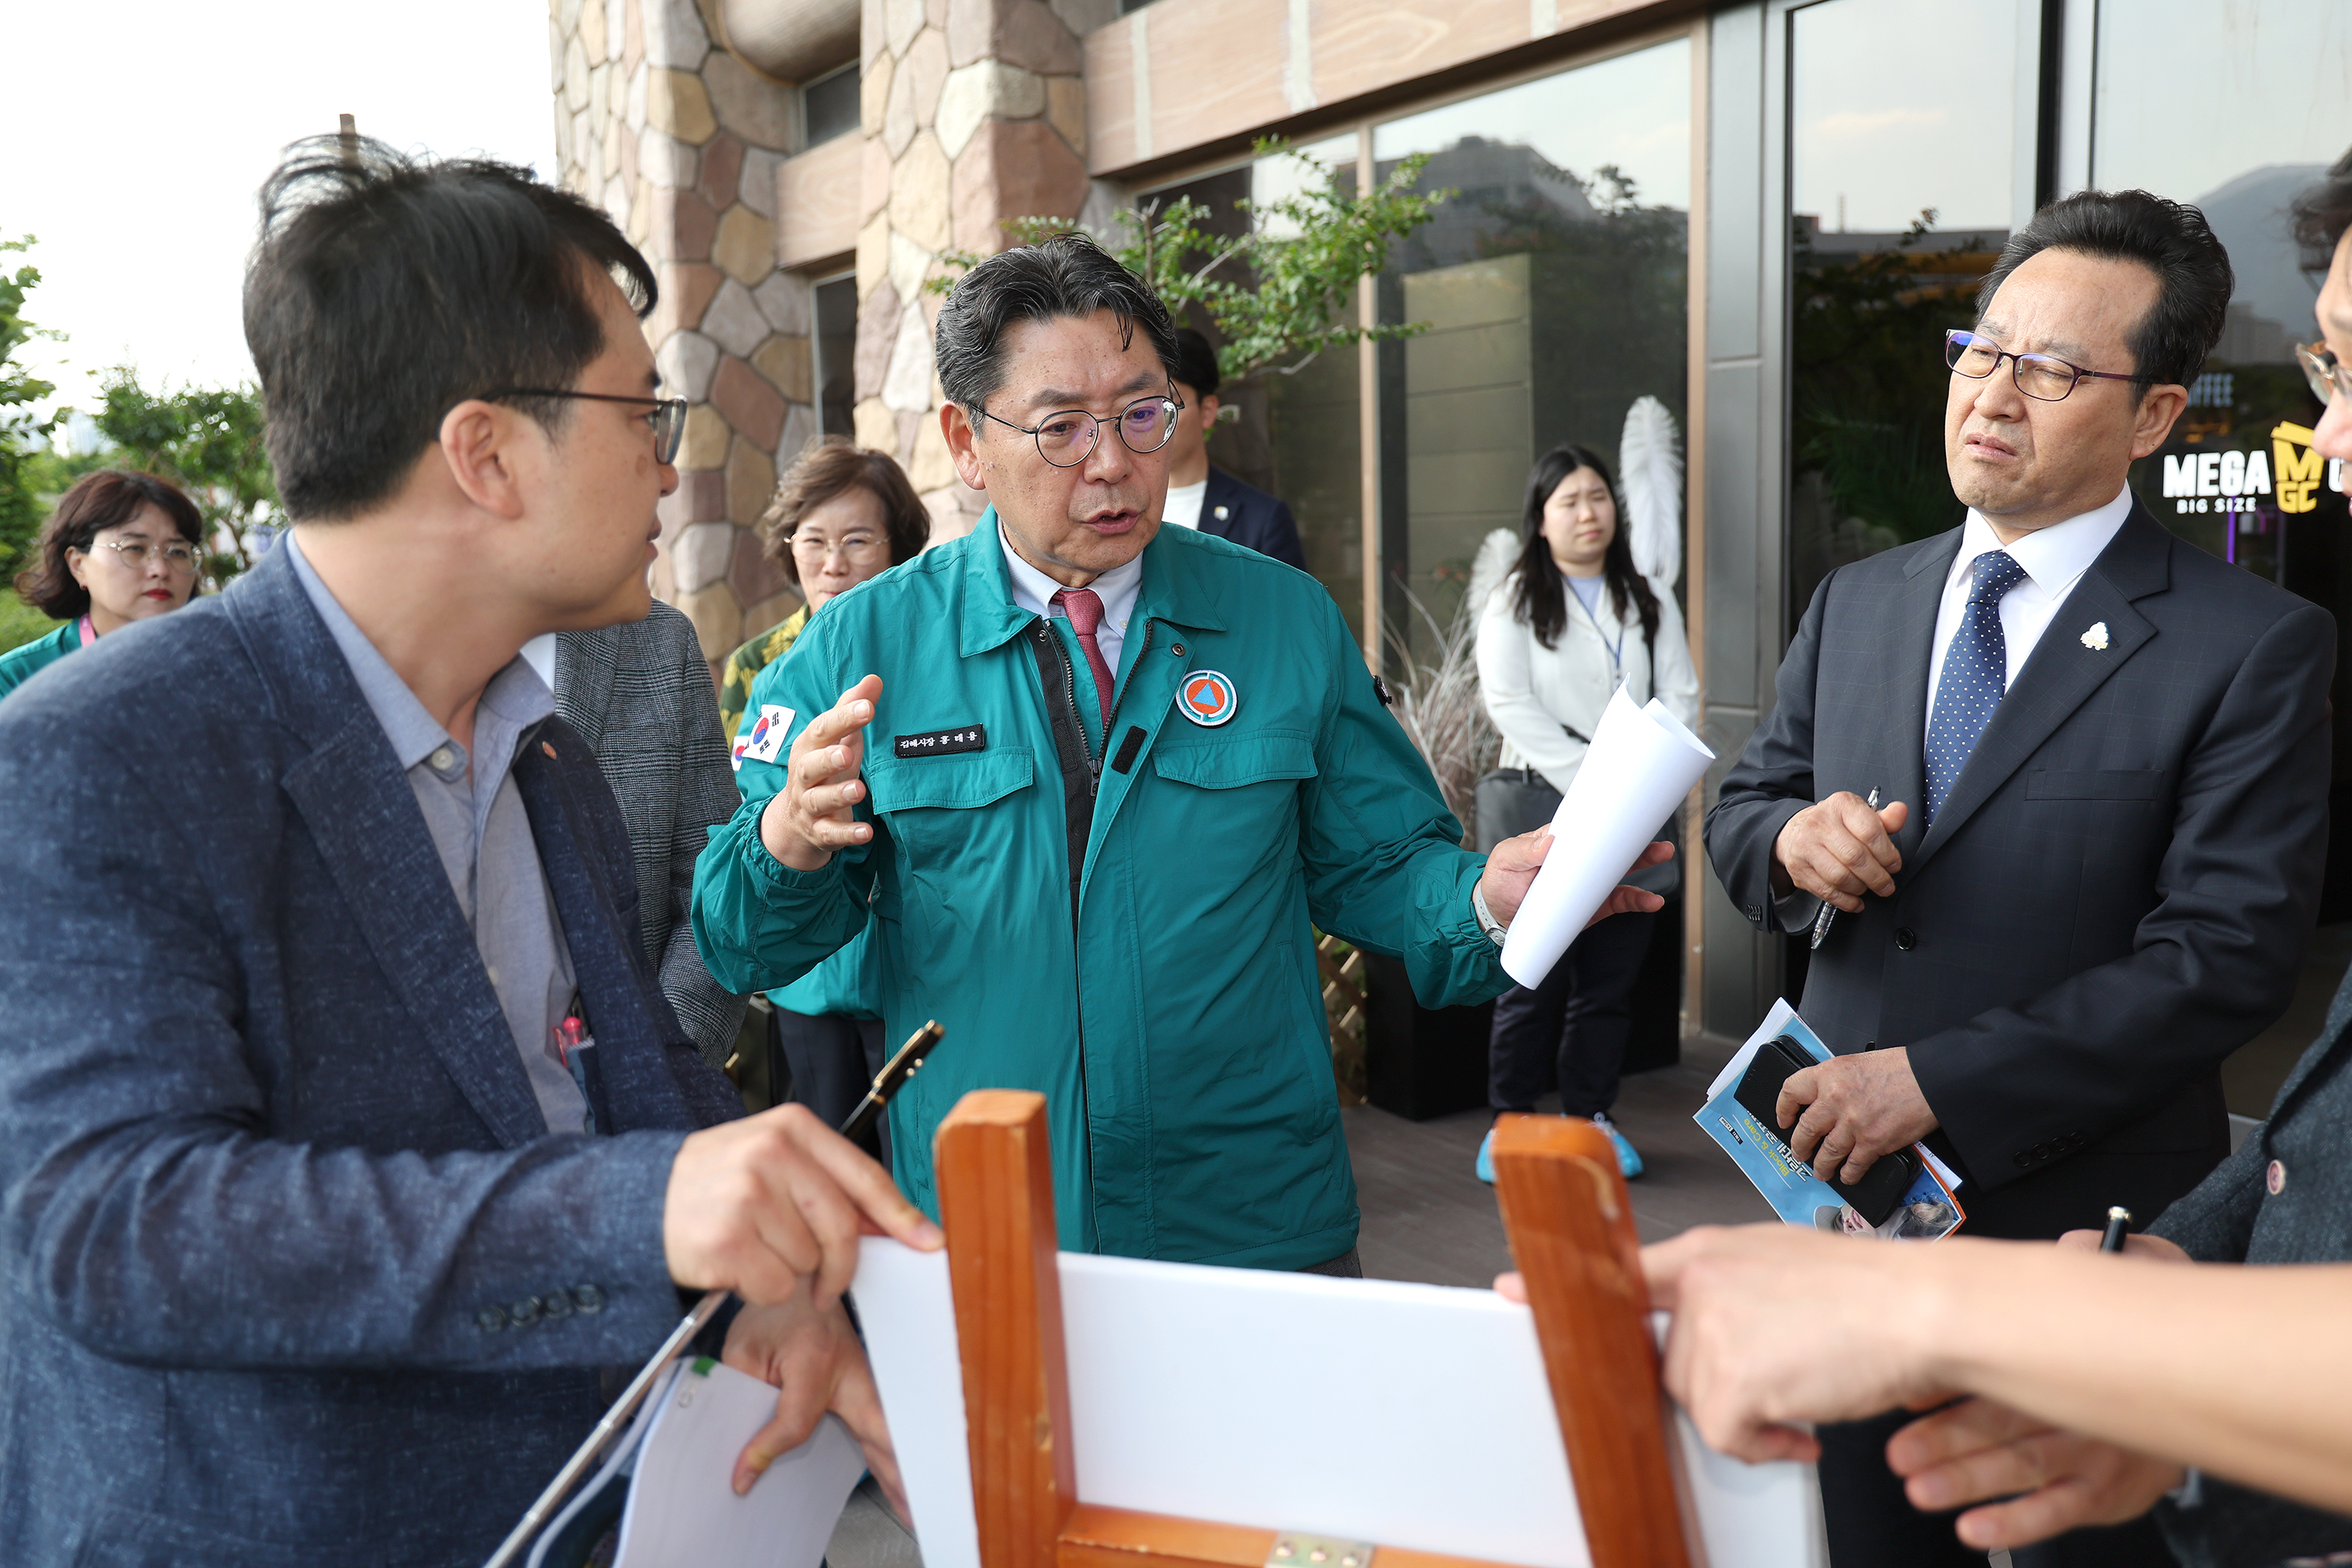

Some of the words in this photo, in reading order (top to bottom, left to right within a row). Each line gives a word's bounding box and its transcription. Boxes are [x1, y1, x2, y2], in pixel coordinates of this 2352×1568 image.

[2163, 450, 2271, 498] MEGA
[2176, 499, 2209, 514] BIG
[2214, 497, 2256, 514] SIZE
[899, 737, 935, 749] 김해시장
[1744, 1118, 1762, 1142] Care
[1761, 1141, 1769, 1150] &
[1768, 1149, 1790, 1176] Block
